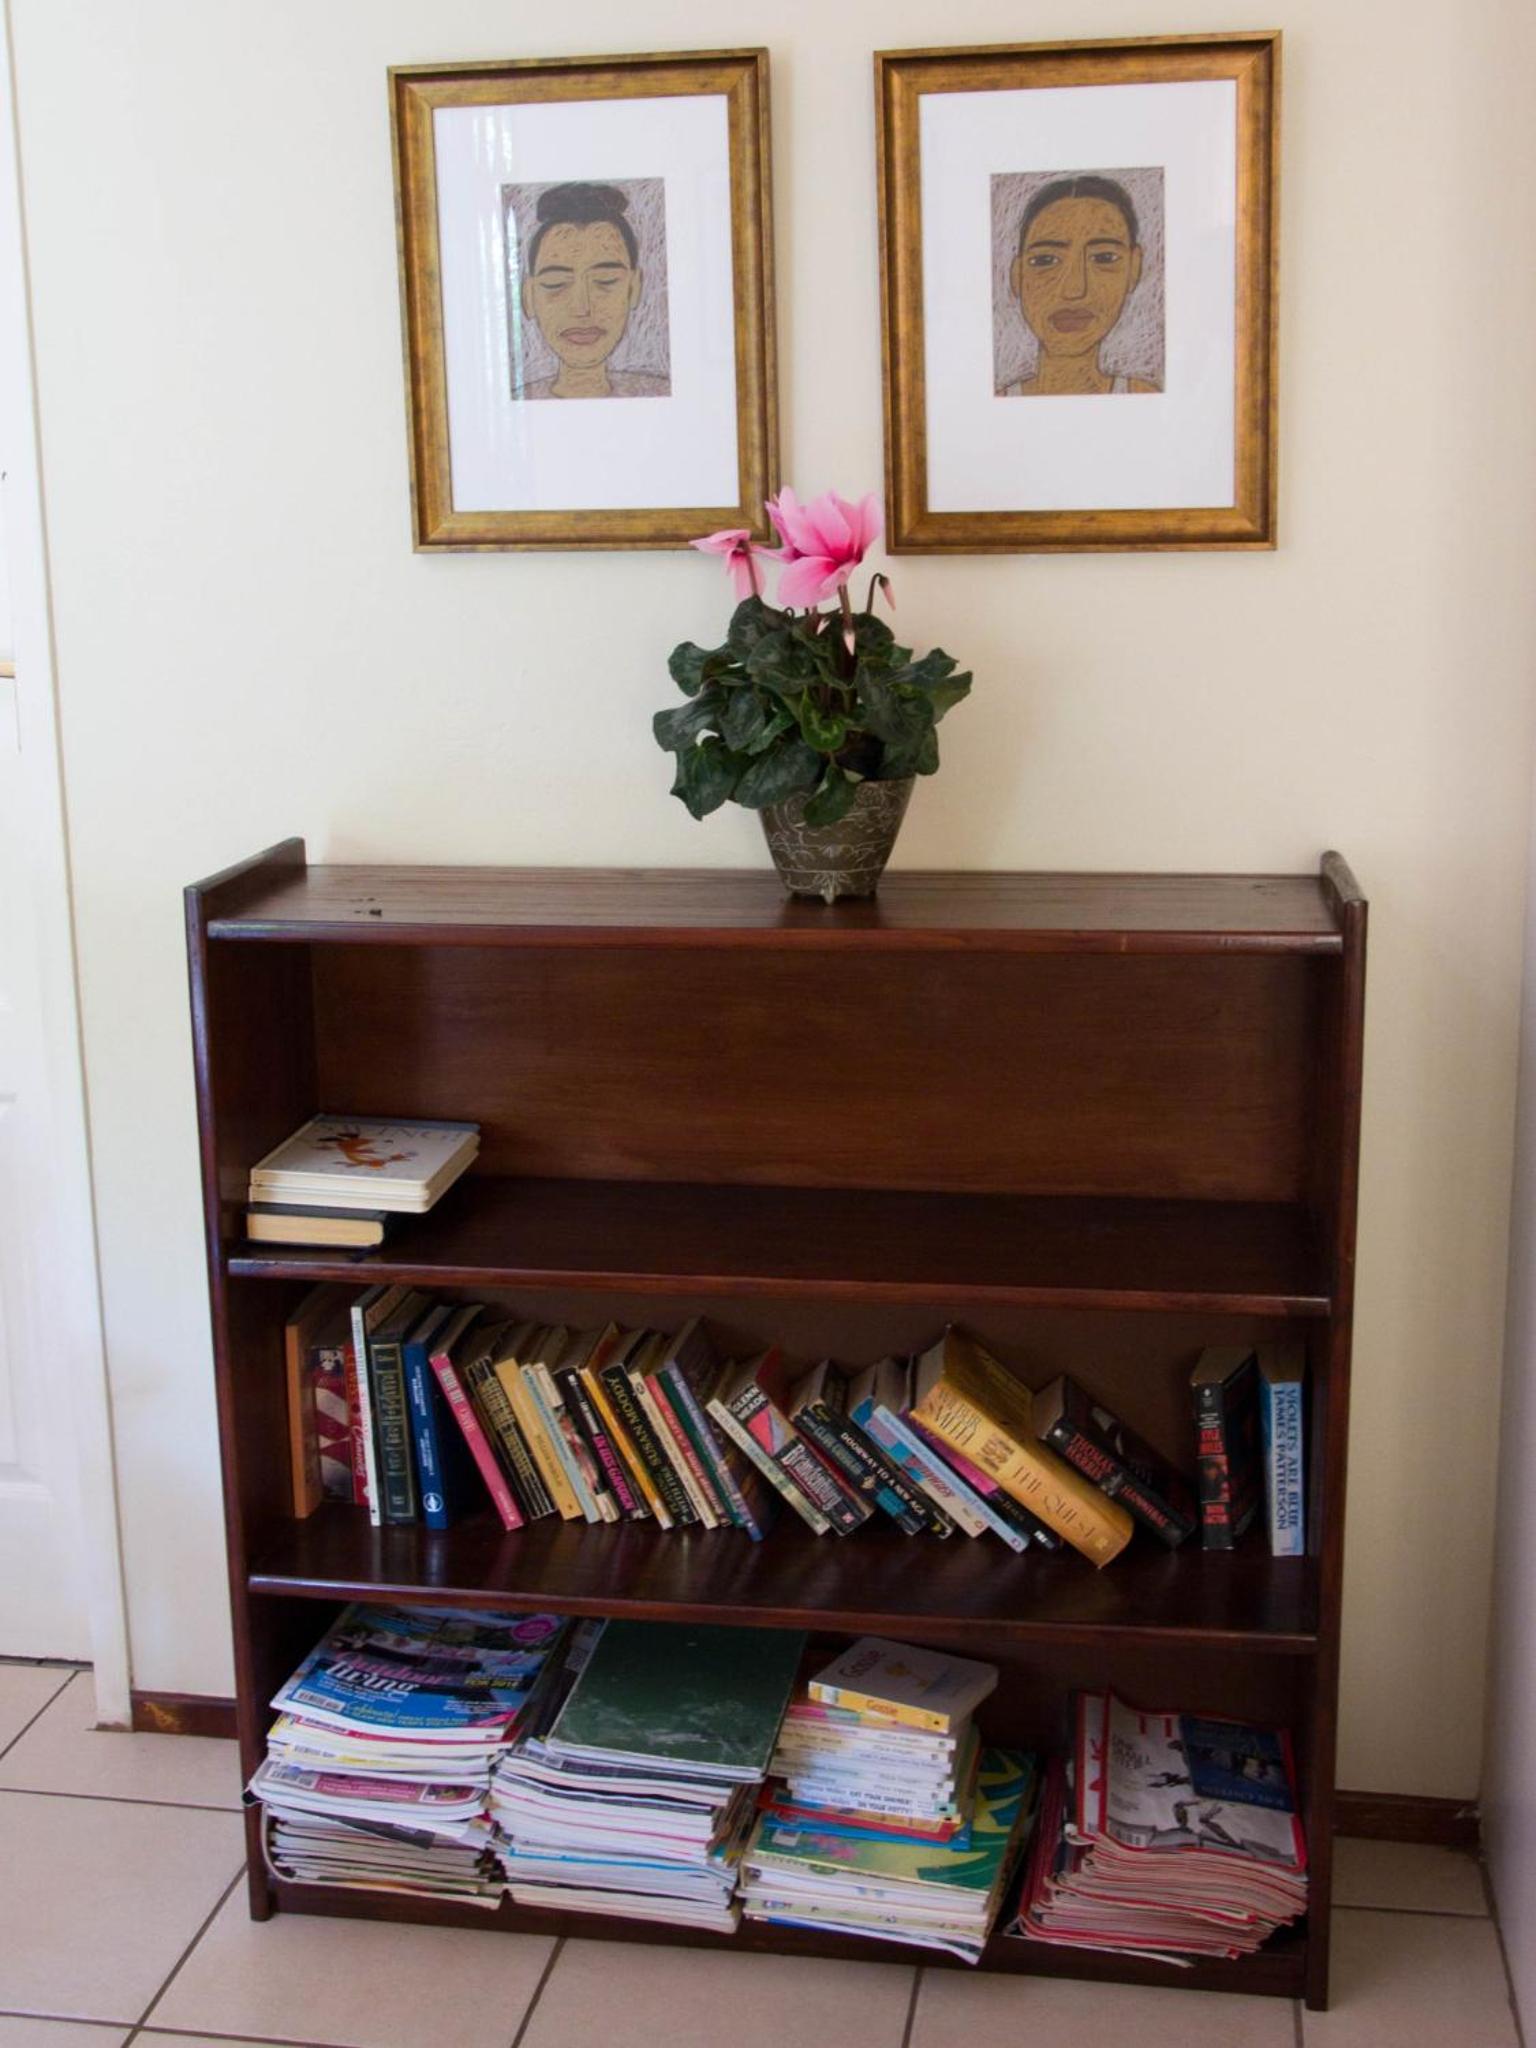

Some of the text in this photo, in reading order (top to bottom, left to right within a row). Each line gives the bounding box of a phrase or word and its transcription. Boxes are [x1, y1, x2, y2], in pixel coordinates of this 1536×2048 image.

[608, 1375, 661, 1468] SUSAN MOODY
[730, 1385, 761, 1411] GLENN
[735, 1393, 768, 1420] MEADE
[925, 1398, 975, 1447] SMITH
[780, 1443, 841, 1513] Brandenburg
[839, 1430, 878, 1469] DOORWAY
[875, 1466, 890, 1481] TO
[886, 1476, 896, 1487] A
[892, 1482, 911, 1502] NEW
[908, 1499, 926, 1517] AGE
[1064, 1444, 1104, 1481] HARRIS
[1071, 1432, 1116, 1475] THOMAS
[1273, 1390, 1287, 1529] JAMES PATTERSON
[1285, 1388, 1298, 1527] VIOLETS ARE BLUE
[607, 1466, 637, 1511] GARDEN
[1013, 1464, 1044, 1495] THE
[1041, 1491, 1096, 1541] QUEST
[1120, 1484, 1169, 1529] HANNIBAL
